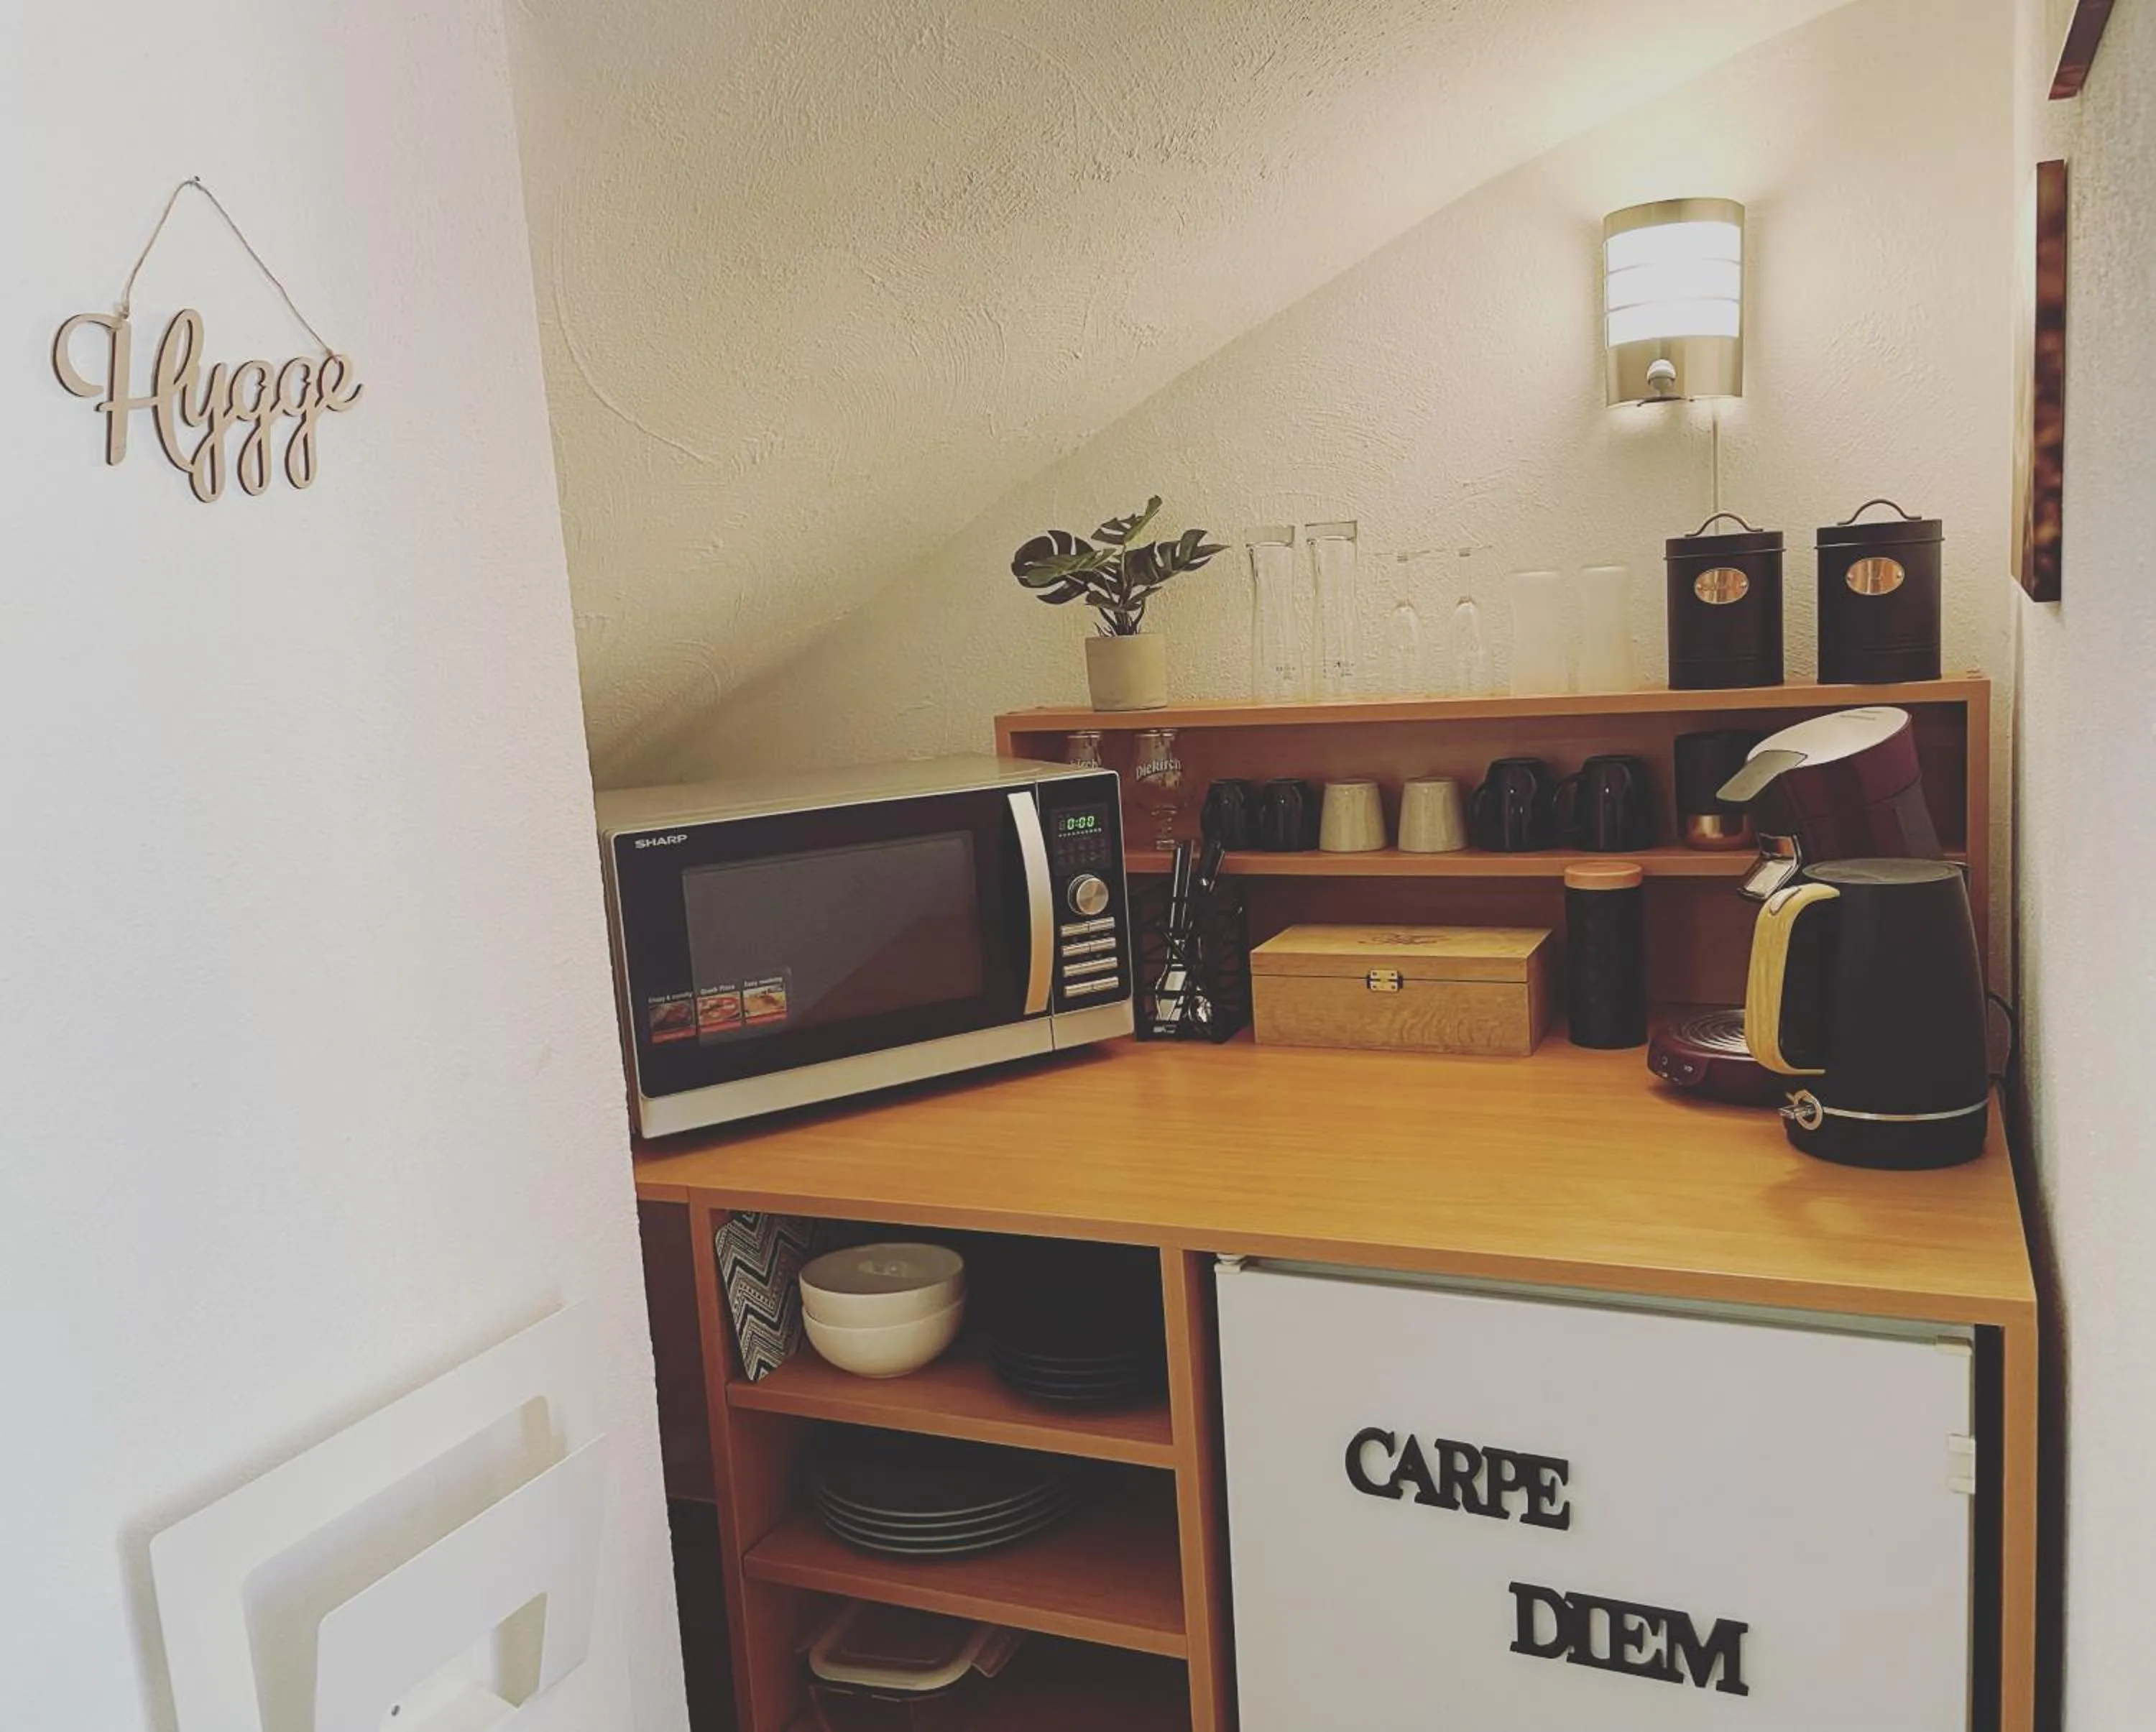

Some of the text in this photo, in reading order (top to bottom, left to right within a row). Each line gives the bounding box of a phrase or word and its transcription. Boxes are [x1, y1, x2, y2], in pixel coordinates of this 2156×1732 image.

[52, 308, 364, 503] Hygge
[635, 834, 688, 849] SHARP
[1067, 816, 1095, 830] 0:00
[1345, 1427, 1570, 1530] CARPE
[1508, 1582, 1749, 1696] DIEM
